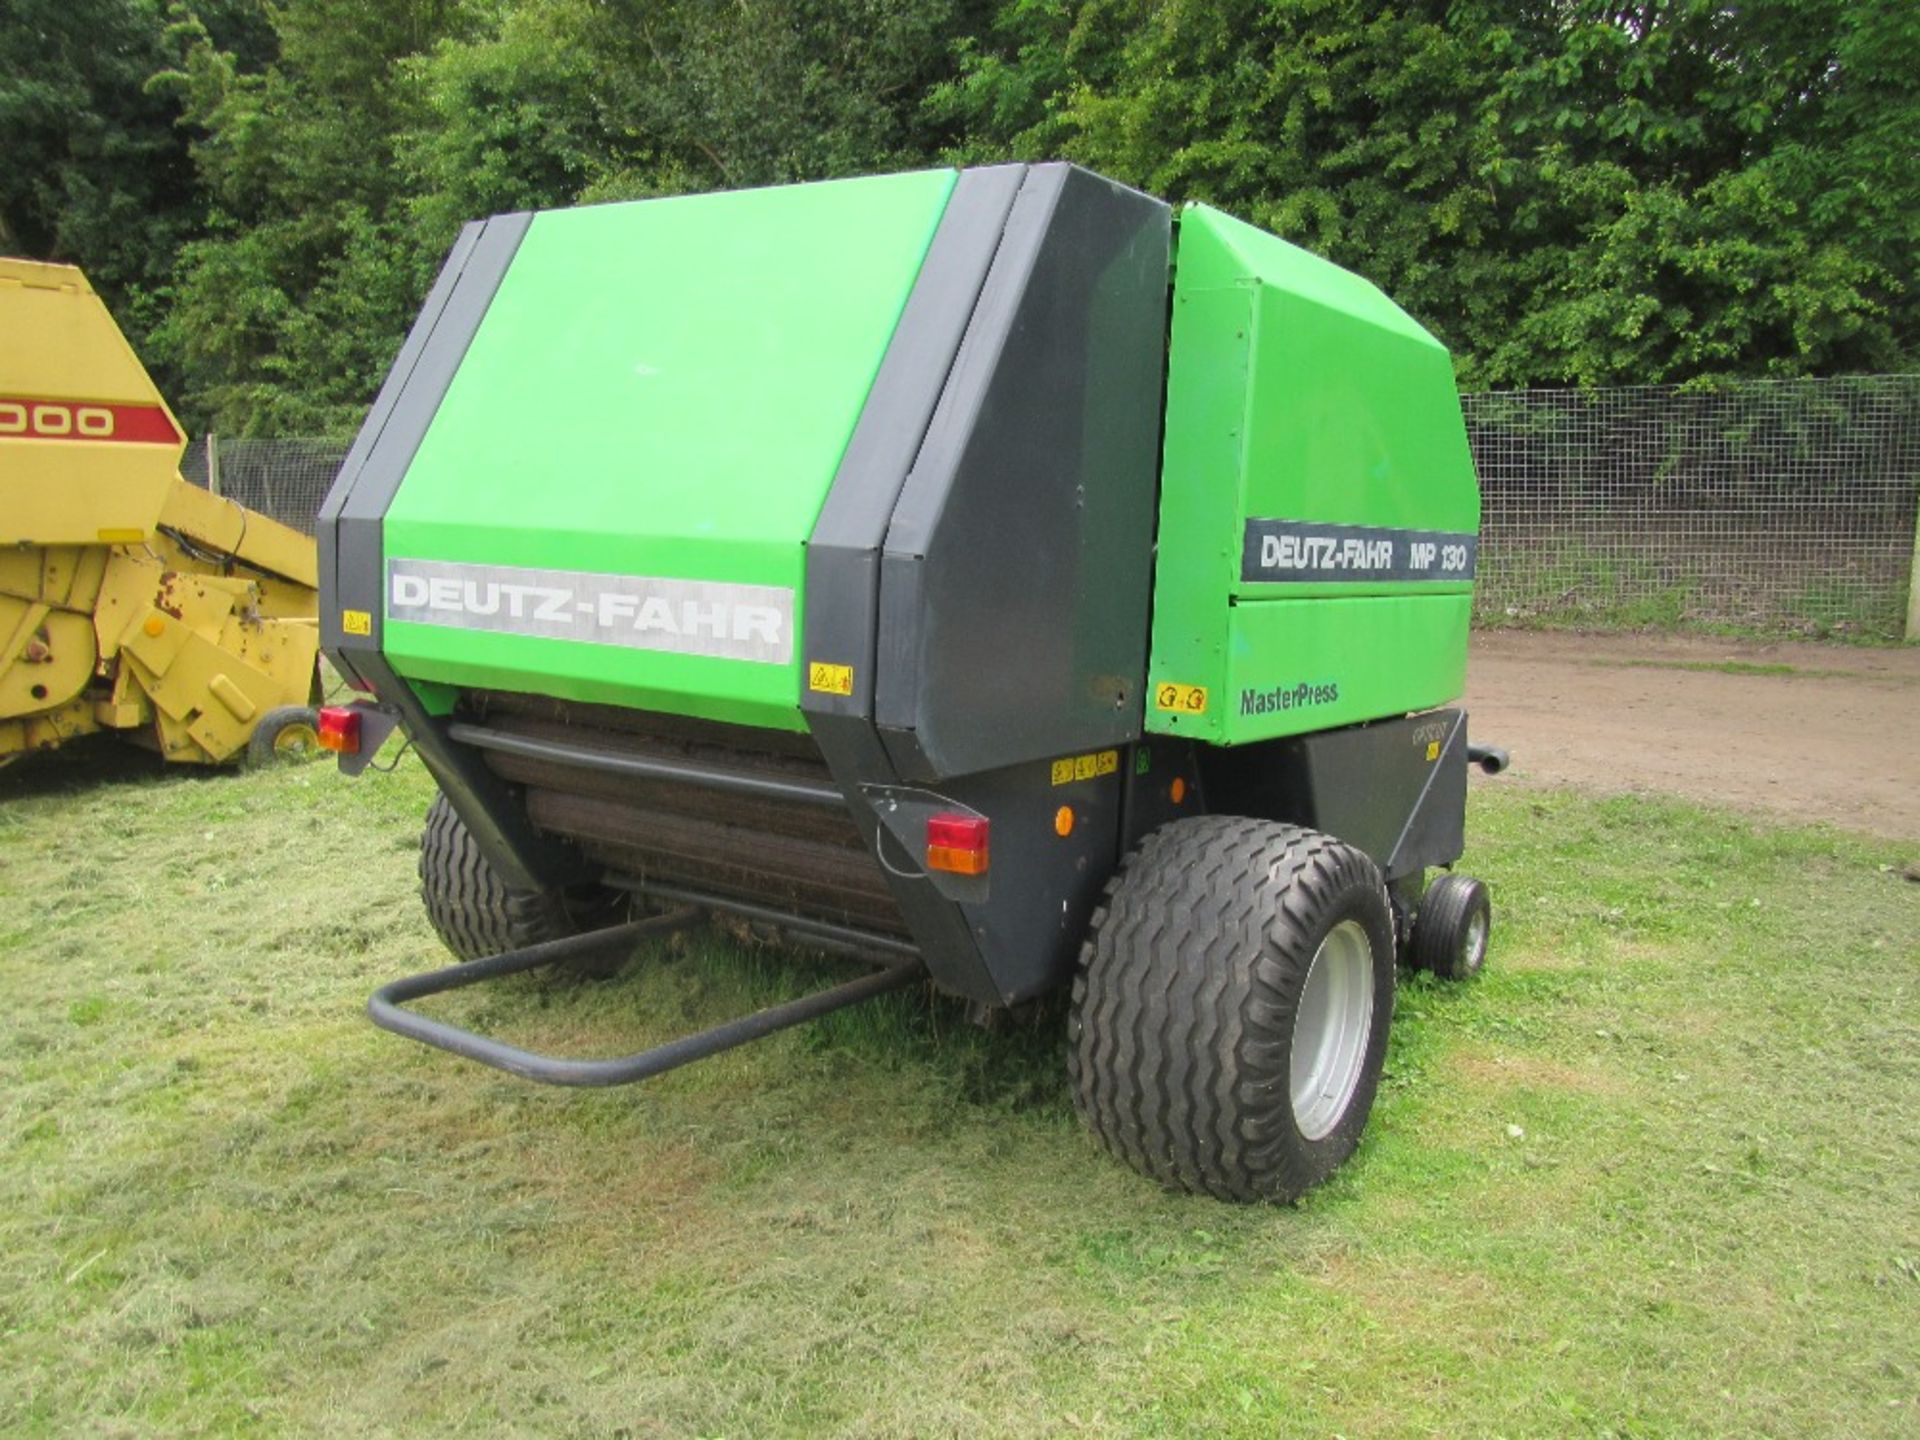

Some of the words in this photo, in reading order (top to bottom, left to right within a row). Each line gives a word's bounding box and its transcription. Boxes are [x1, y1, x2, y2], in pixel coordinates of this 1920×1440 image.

[1260, 535, 1393, 569] DEUTZ-FAHR
[1409, 543, 1437, 569] MP
[1441, 545, 1467, 571] 130
[392, 573, 783, 645] DEUTZ-FAHR
[1240, 683, 1339, 716] MasterPress
